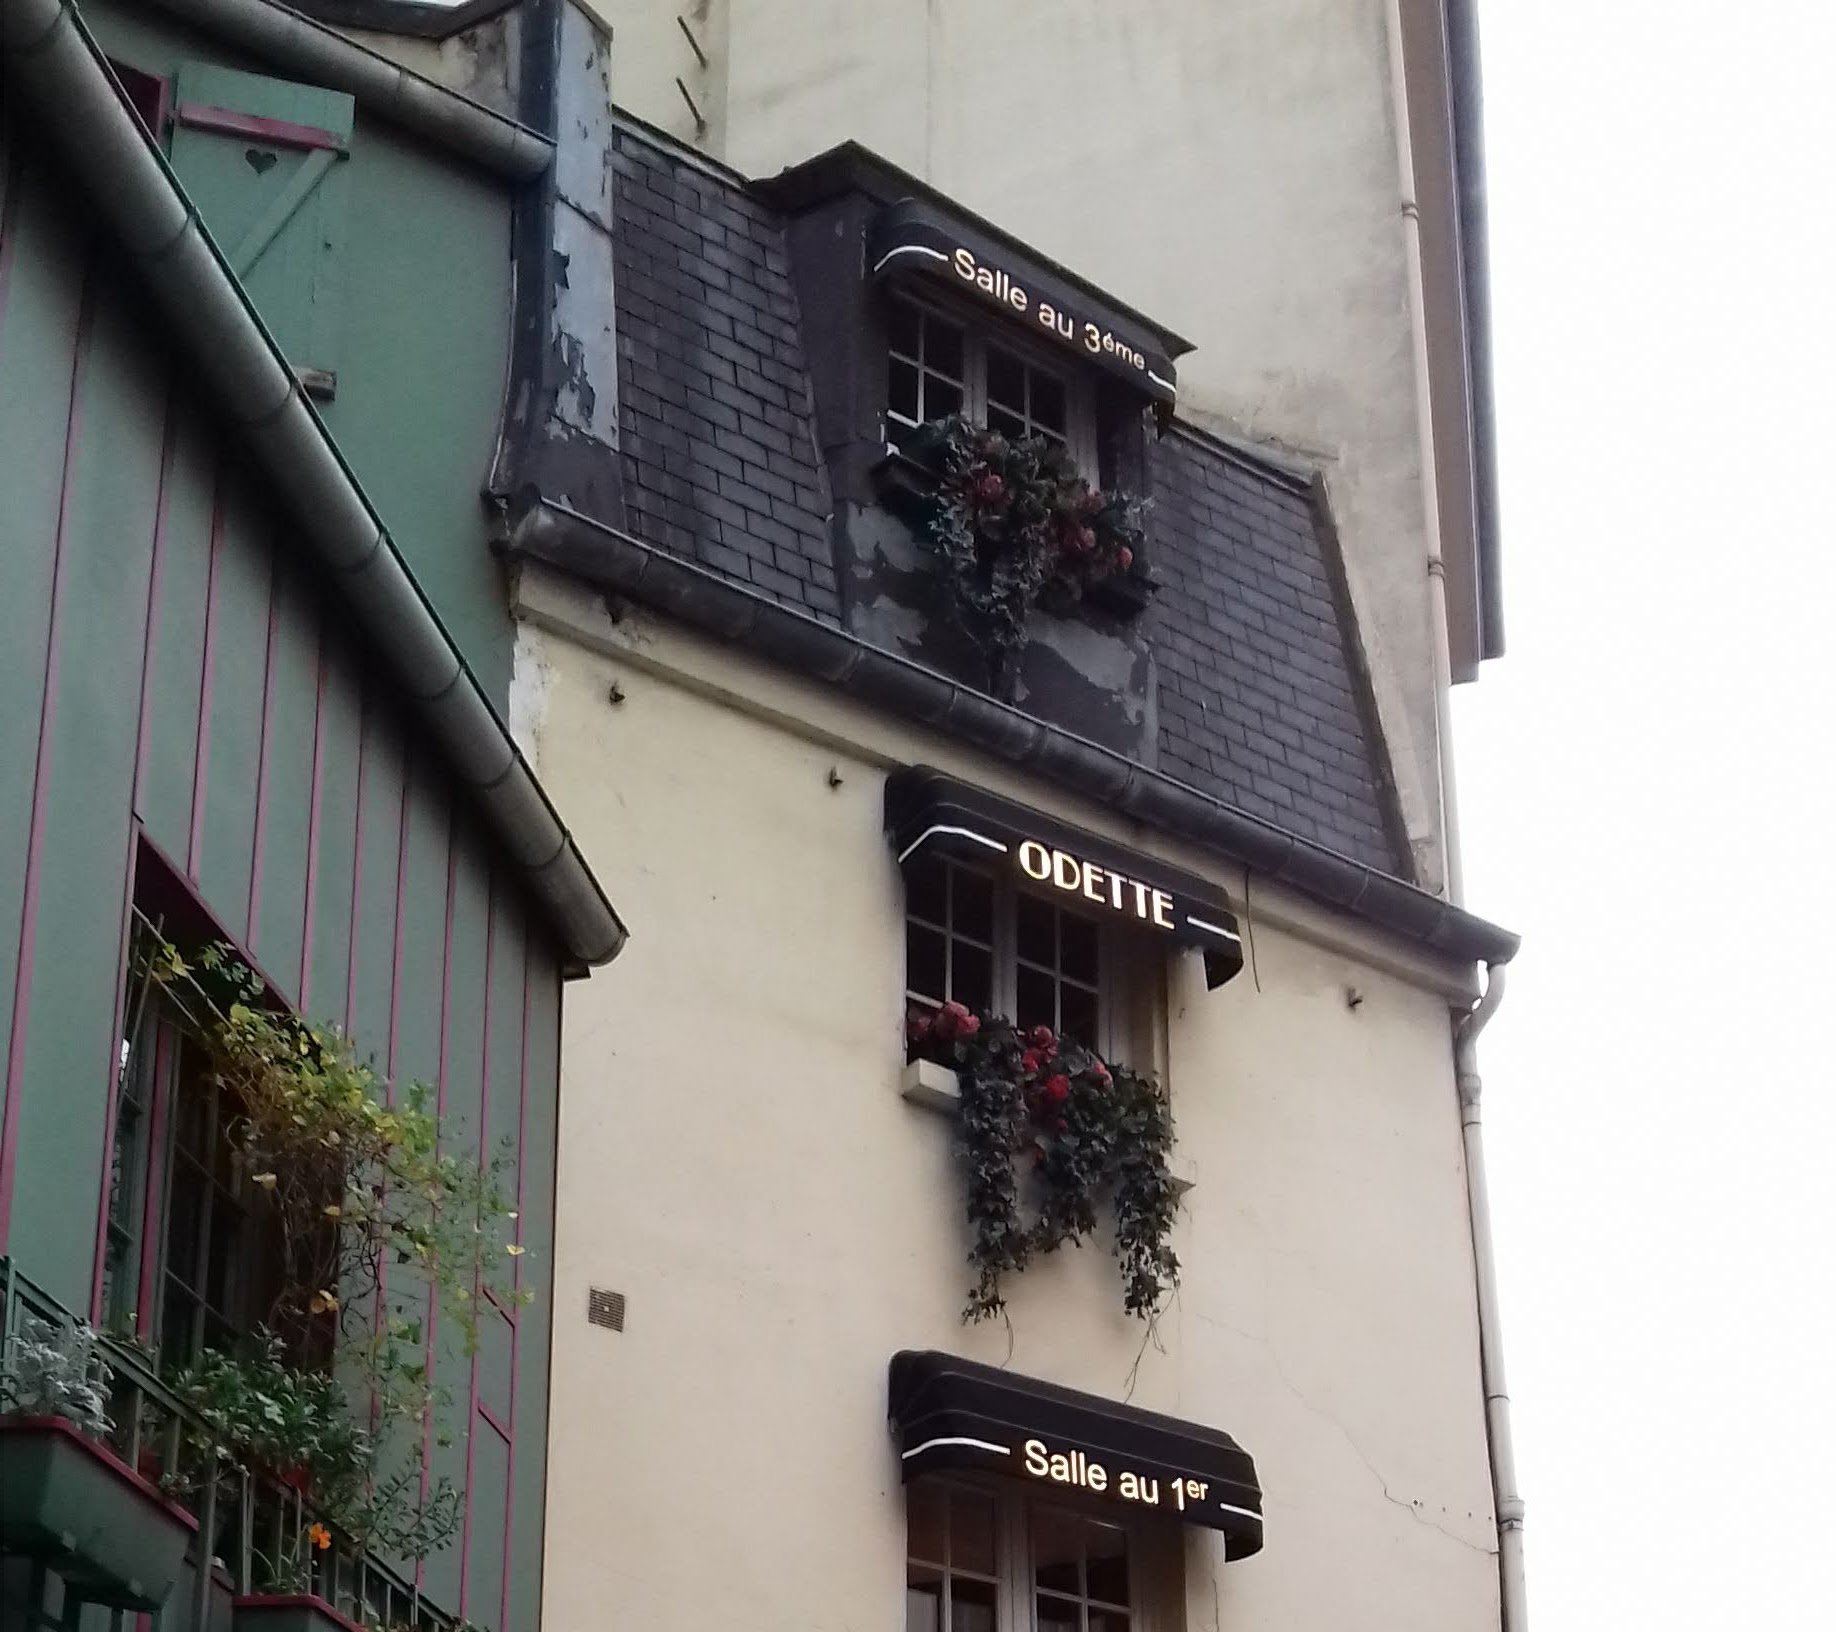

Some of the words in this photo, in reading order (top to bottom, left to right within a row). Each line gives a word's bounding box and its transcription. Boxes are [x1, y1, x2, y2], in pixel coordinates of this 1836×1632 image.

[954, 248, 1028, 313] Salle
[1038, 303, 1074, 341] au
[1018, 839, 1176, 930] ODETTE
[1024, 1439, 1108, 1492] Salle
[1119, 1471, 1160, 1505] au
[1171, 1477, 1209, 1511] 1er
